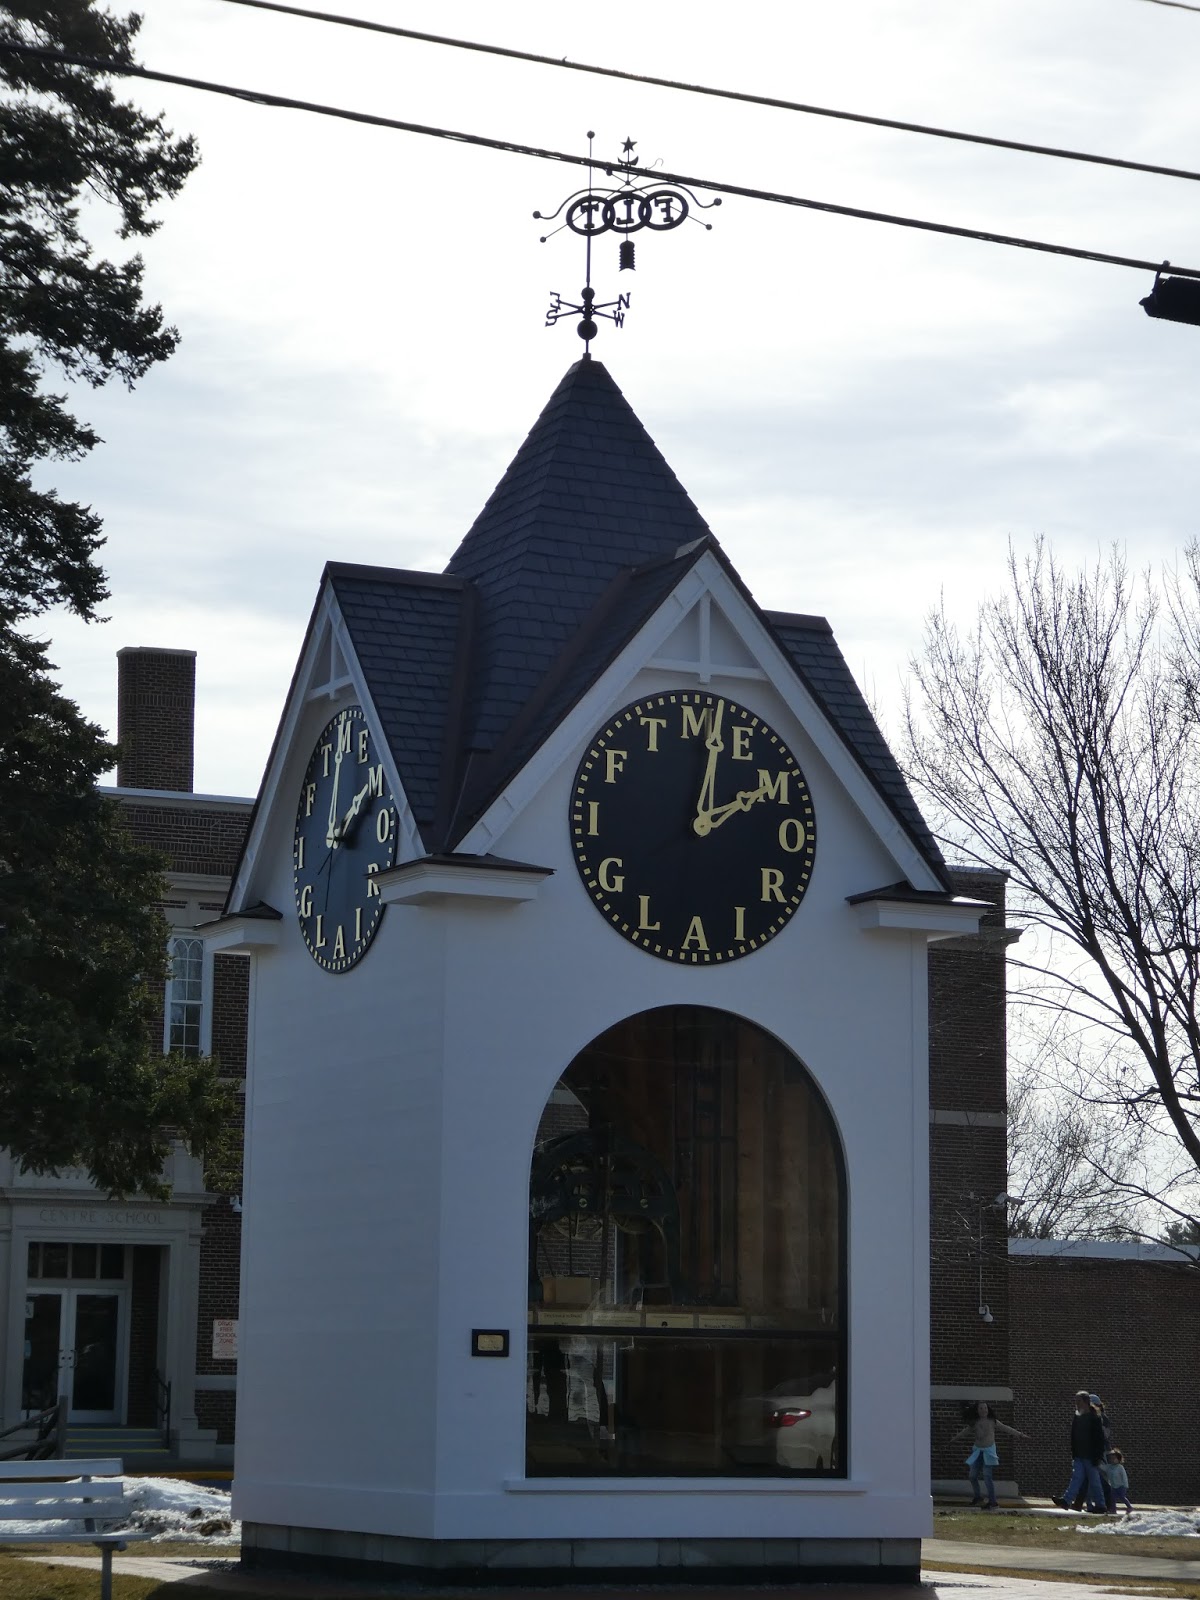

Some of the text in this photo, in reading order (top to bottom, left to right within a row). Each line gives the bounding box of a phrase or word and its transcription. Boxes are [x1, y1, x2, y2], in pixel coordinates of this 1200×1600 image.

[617, 292, 631, 311] N
[613, 309, 625, 328] W
[40, 1209, 165, 1225] CENTRE SCHOOL
